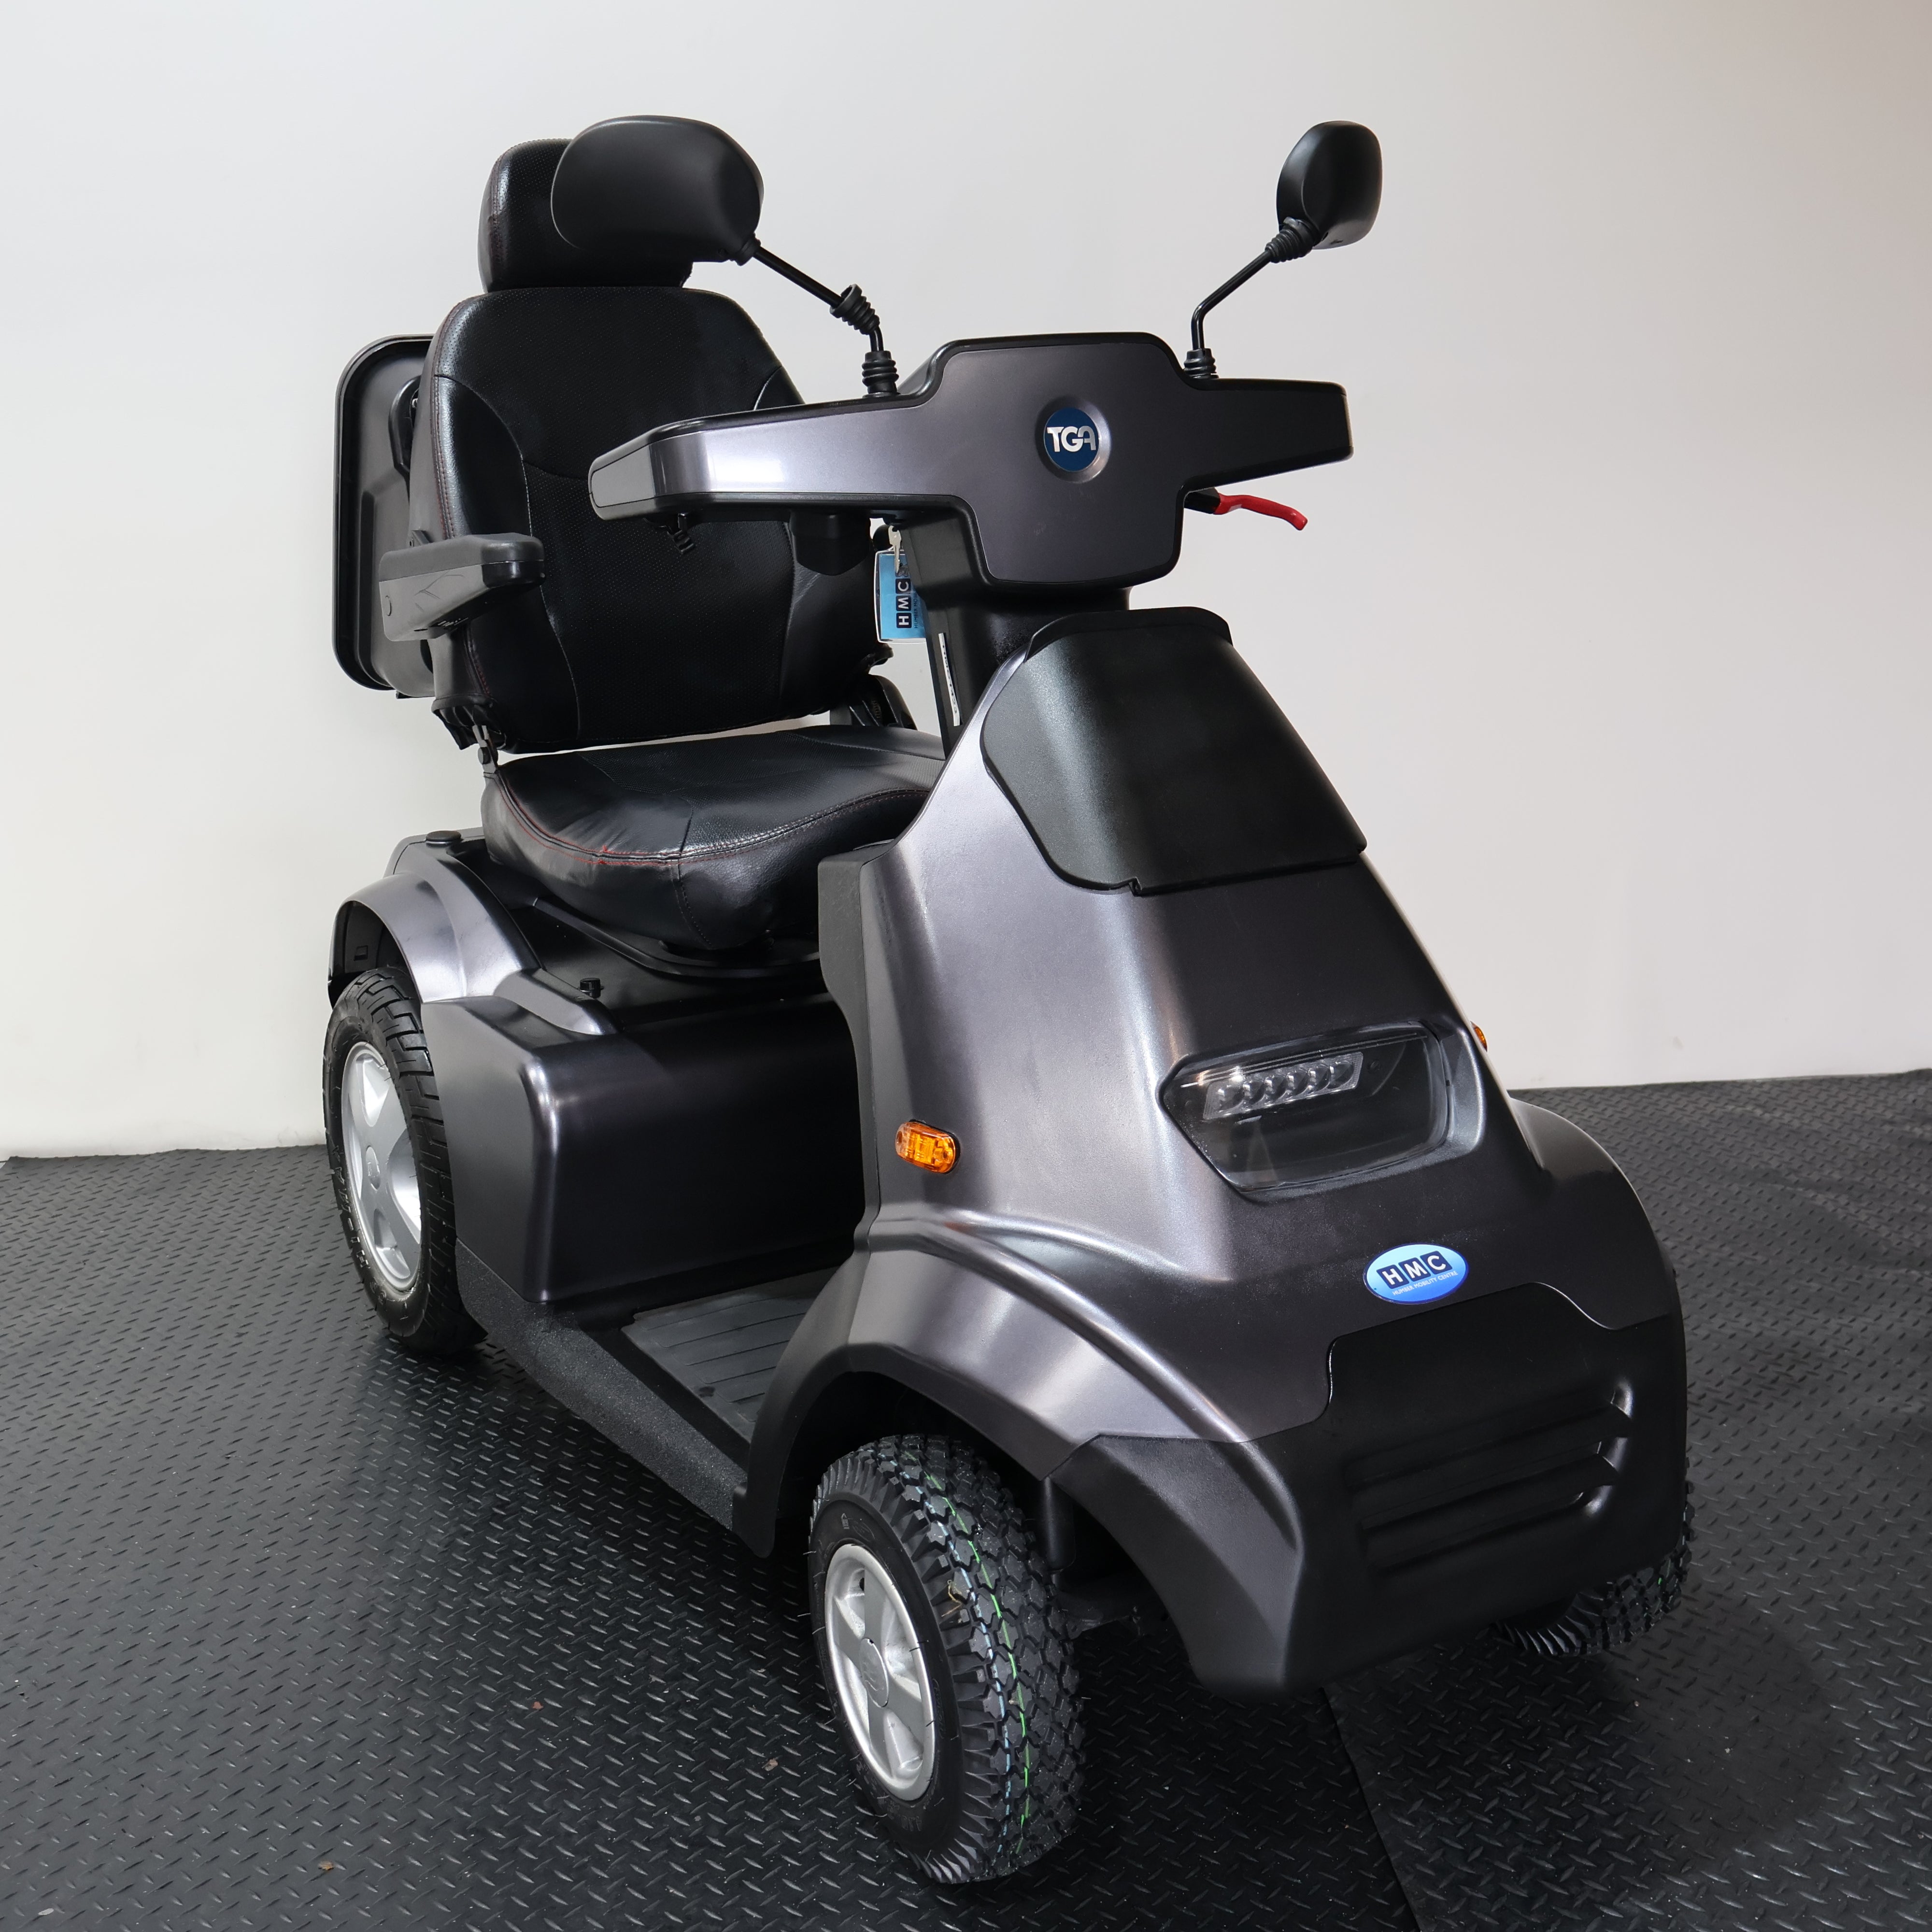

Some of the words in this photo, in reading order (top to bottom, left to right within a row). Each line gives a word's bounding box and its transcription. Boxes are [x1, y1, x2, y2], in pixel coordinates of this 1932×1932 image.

[1047, 426, 1096, 452] TGA
[897, 581, 909, 625] HMC
[1382, 1255, 1446, 1285] HMC
[1392, 1285, 1414, 1295] HUMBER
[1414, 1277, 1437, 1289] MOBILITY
[1438, 1270, 1458, 1280] CENTRE
